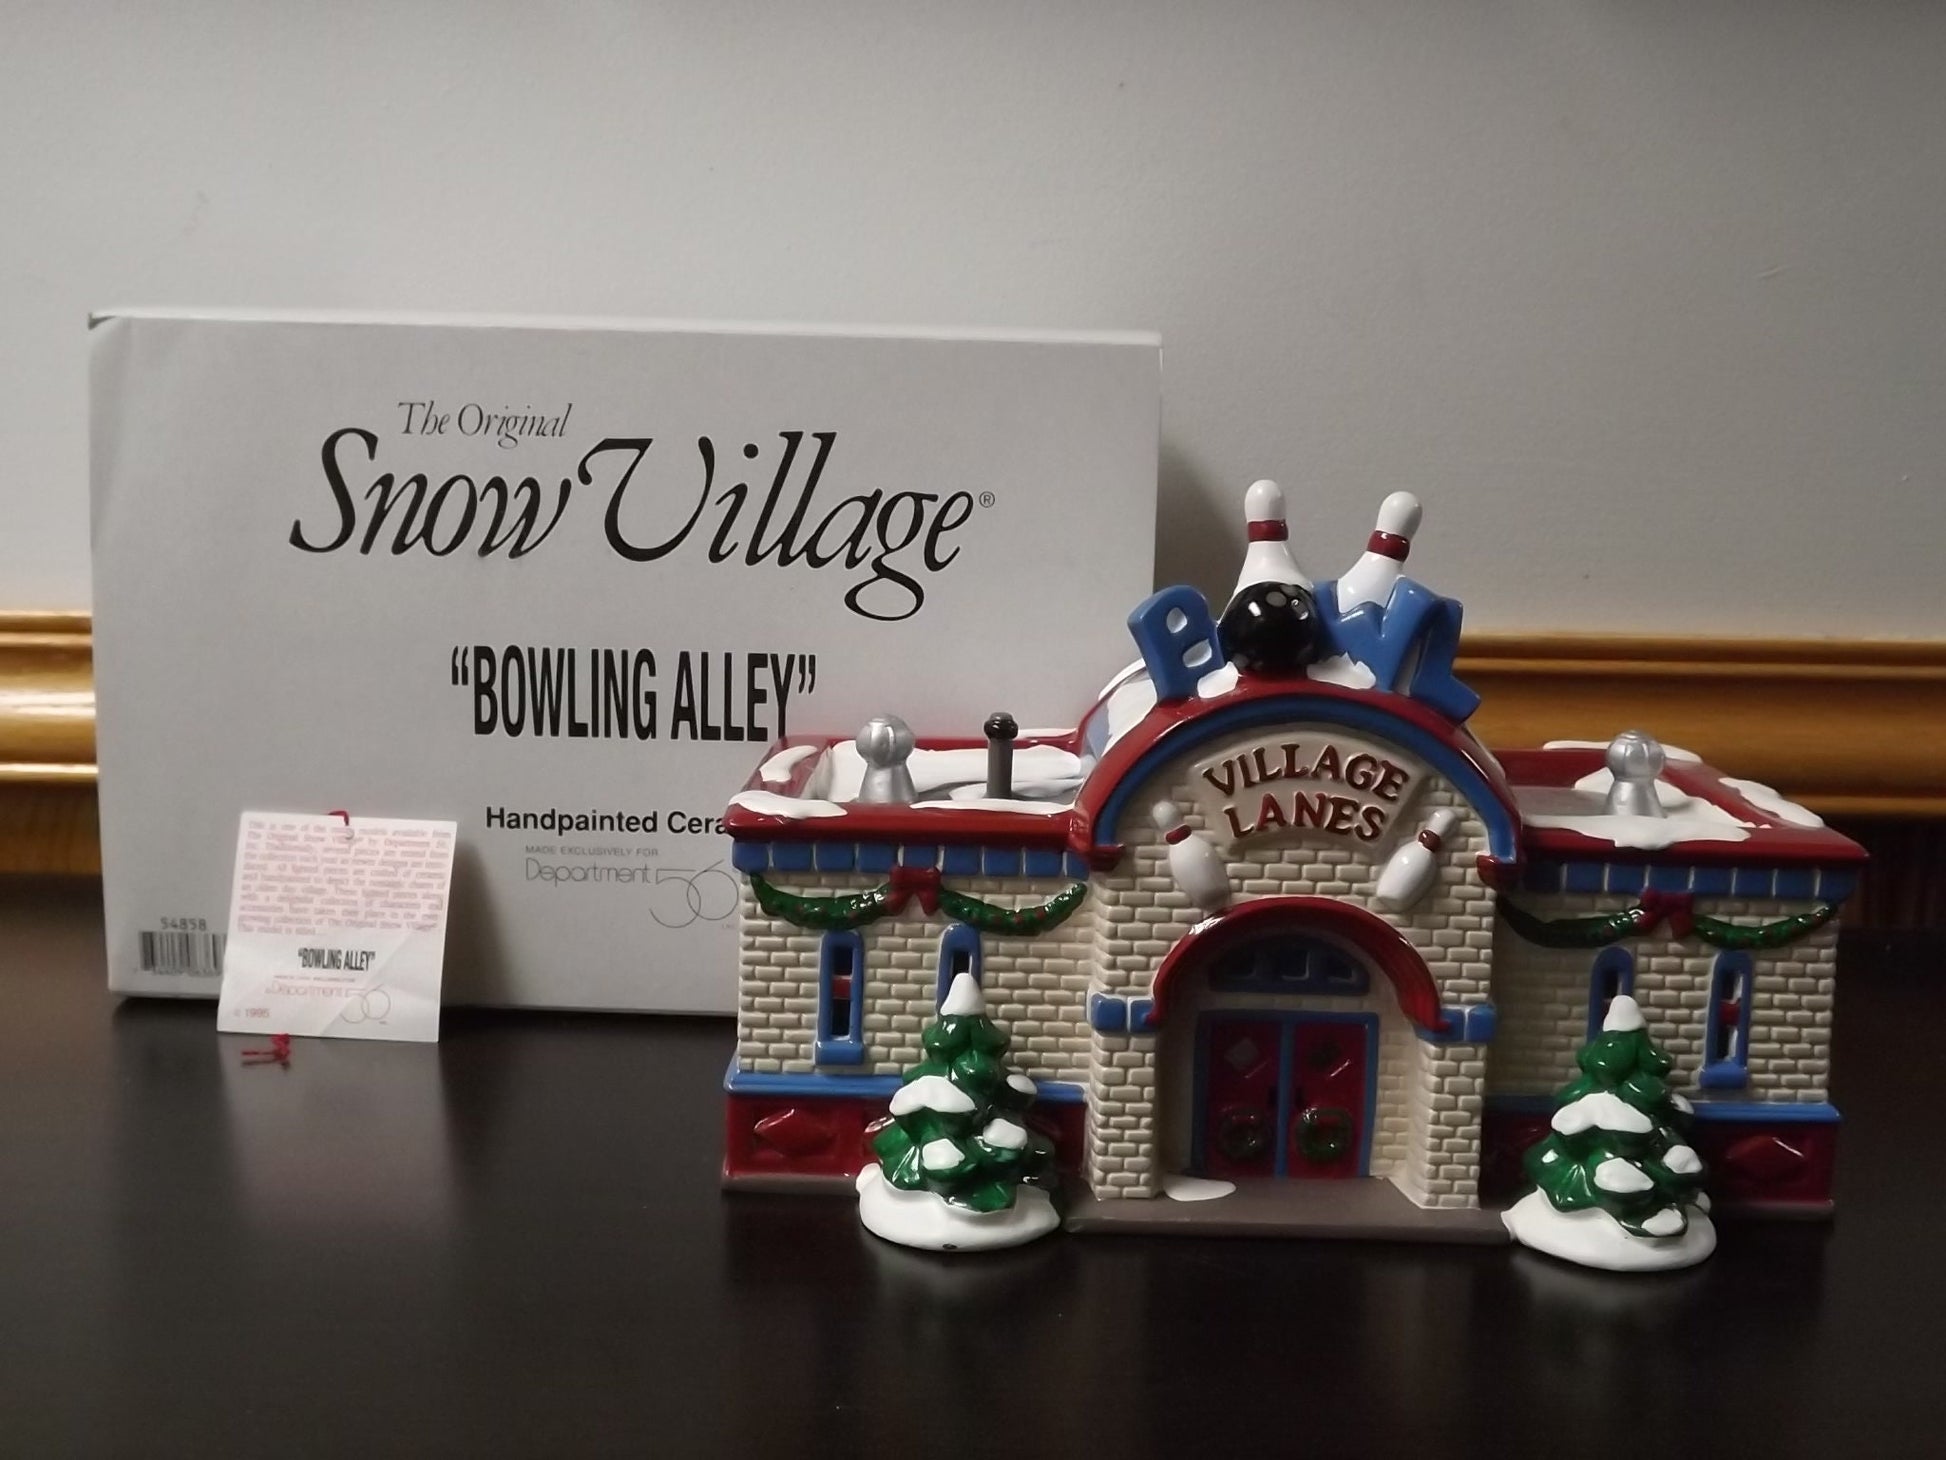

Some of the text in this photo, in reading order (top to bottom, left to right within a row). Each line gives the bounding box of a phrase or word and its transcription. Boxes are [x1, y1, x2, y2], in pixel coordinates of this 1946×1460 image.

[397, 400, 573, 449] The Original
[289, 427, 573, 559] Snow
[451, 645, 816, 742] “BOWLING ALLEY”
[1202, 743, 1410, 801] VILLAGE
[486, 806, 658, 836] Handpainted
[1223, 791, 1389, 841] LANES
[525, 844, 659, 857] MADE EXCLUSIVELY FOR
[525, 857, 739, 928] Department 56
